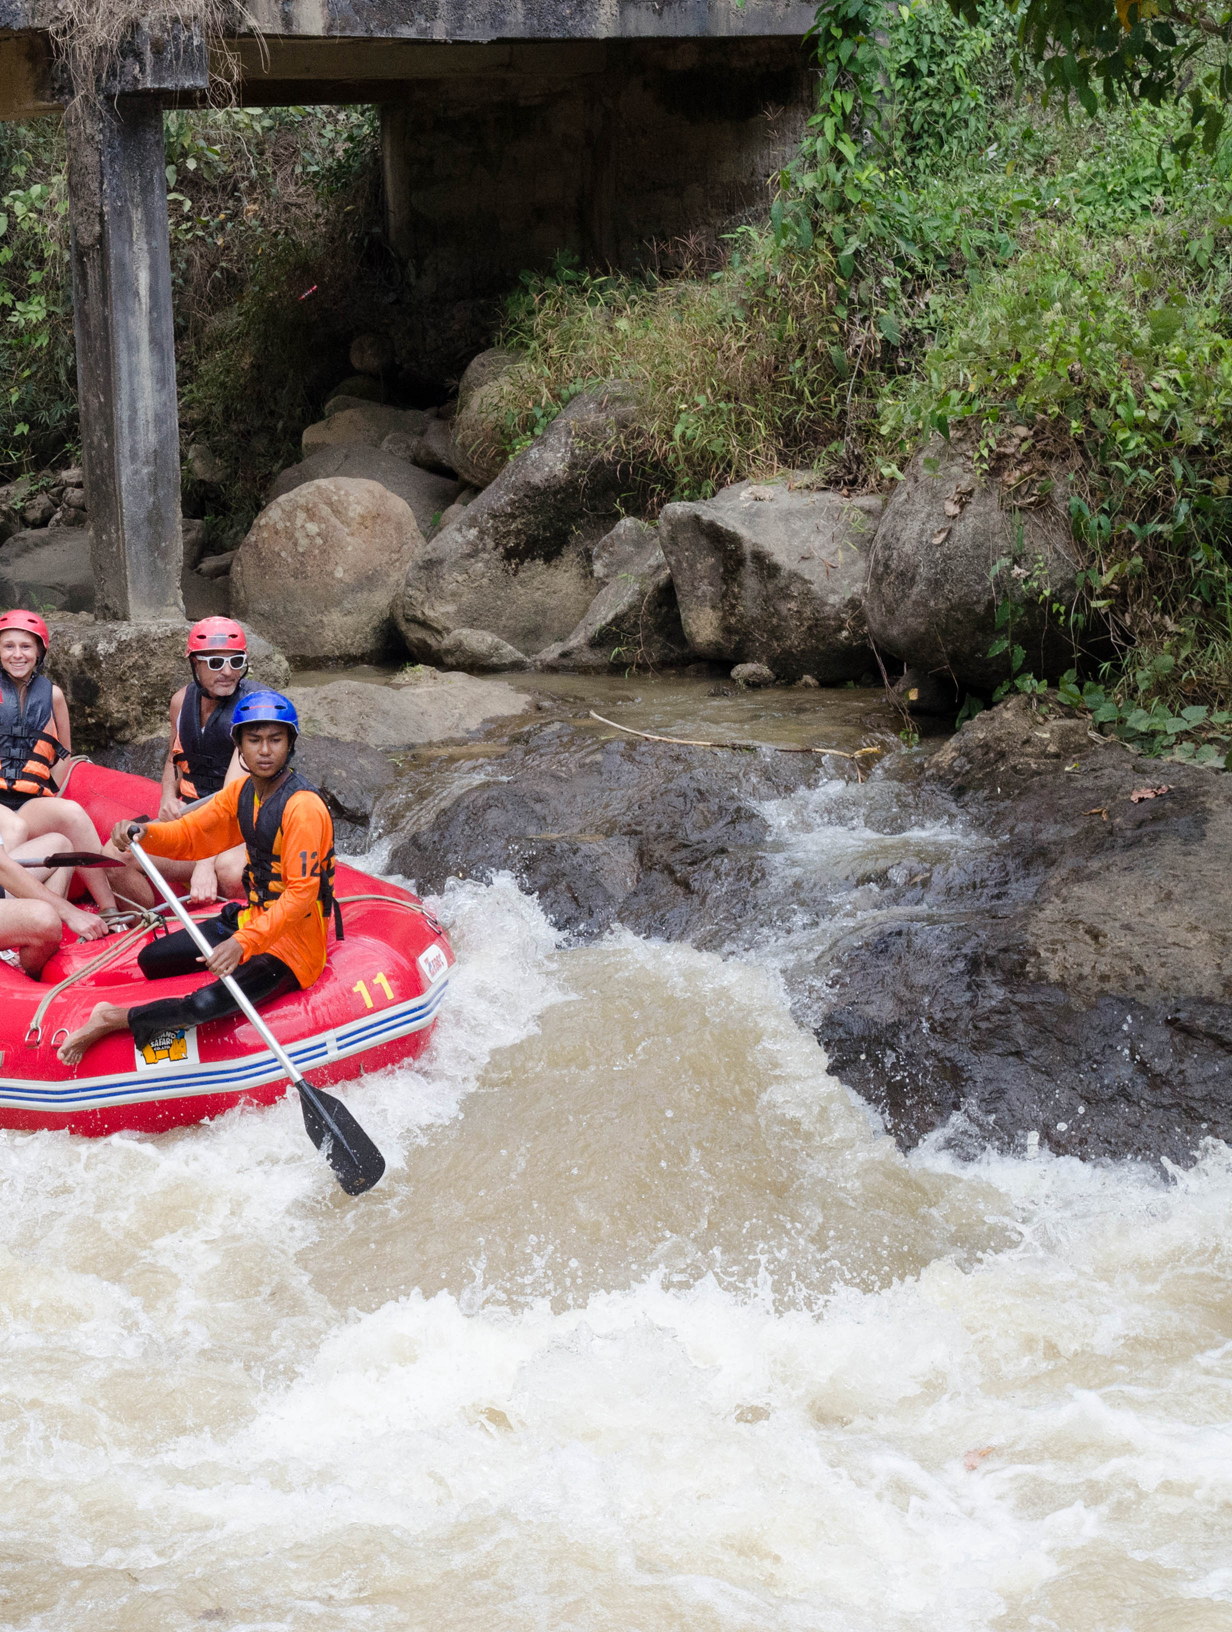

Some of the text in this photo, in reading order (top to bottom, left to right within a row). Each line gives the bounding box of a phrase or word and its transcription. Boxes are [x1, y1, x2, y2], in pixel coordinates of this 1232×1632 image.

[299, 851, 320, 877] 12
[352, 972, 394, 1008] 11
[150, 1037, 173, 1047] SAFARI
[159, 1031, 176, 1039] AND
